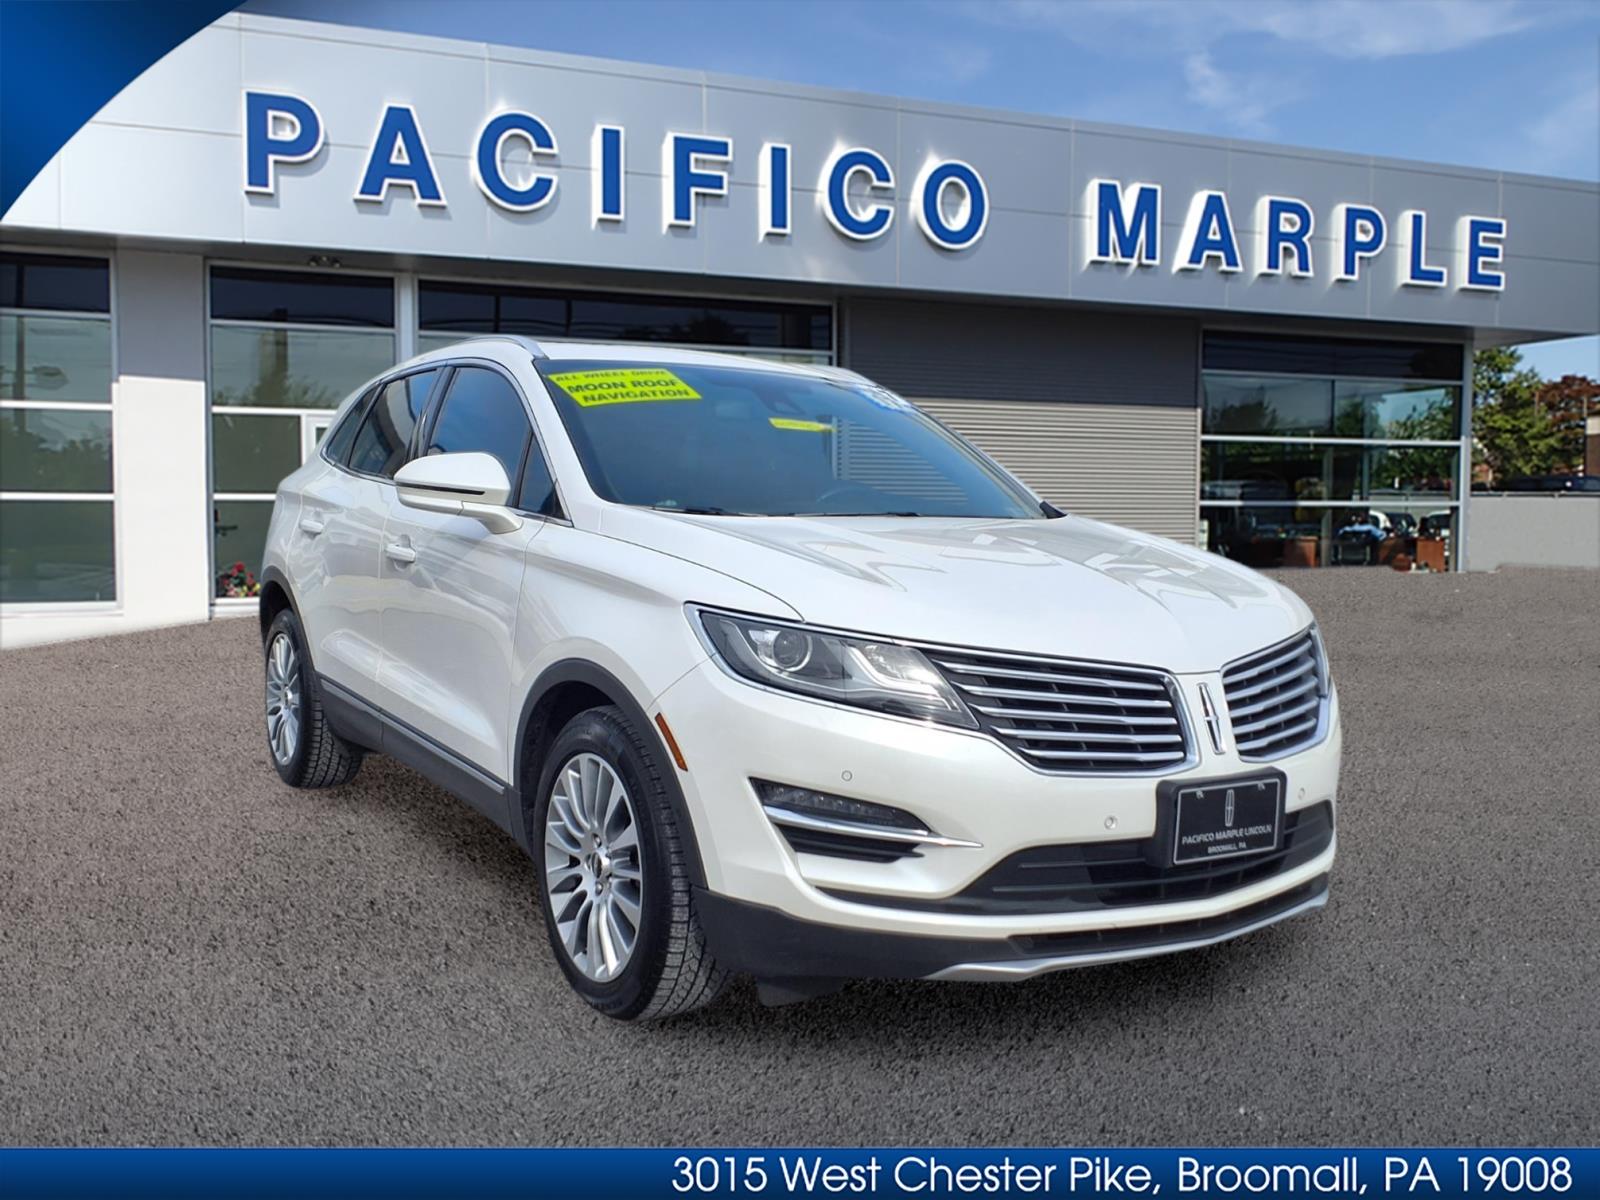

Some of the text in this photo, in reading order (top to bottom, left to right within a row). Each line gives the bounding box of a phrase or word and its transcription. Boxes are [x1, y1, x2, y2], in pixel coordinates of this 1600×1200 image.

[243, 89, 1507, 292] PACIFICO MARPLE
[584, 371, 626, 379] WHEEL
[567, 379, 676, 393] MOON ROOF
[583, 389, 689, 402] NAVIGATION
[1182, 824, 1272, 844] PACIFICO MARPLE LINCOLN
